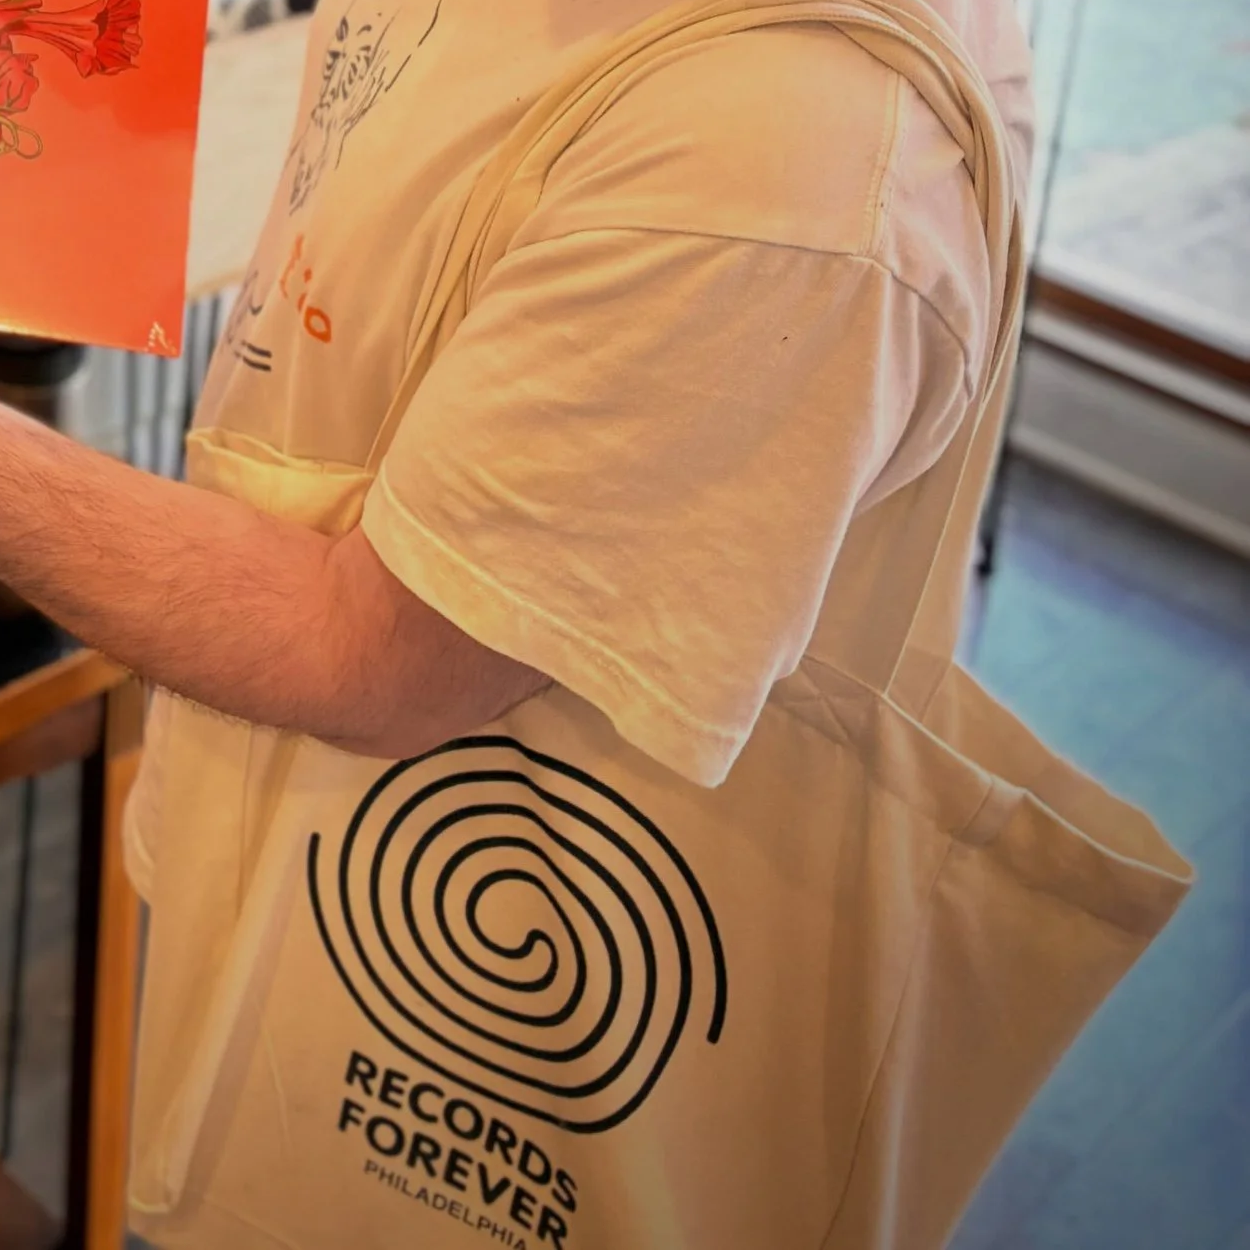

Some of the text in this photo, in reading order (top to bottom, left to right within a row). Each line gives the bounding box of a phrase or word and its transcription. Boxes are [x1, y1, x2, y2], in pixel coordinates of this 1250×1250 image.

[338, 1097, 569, 1250] FOREVER
[344, 1050, 578, 1213] RECORDS
[363, 1159, 529, 1250] PHILADELPHIA
